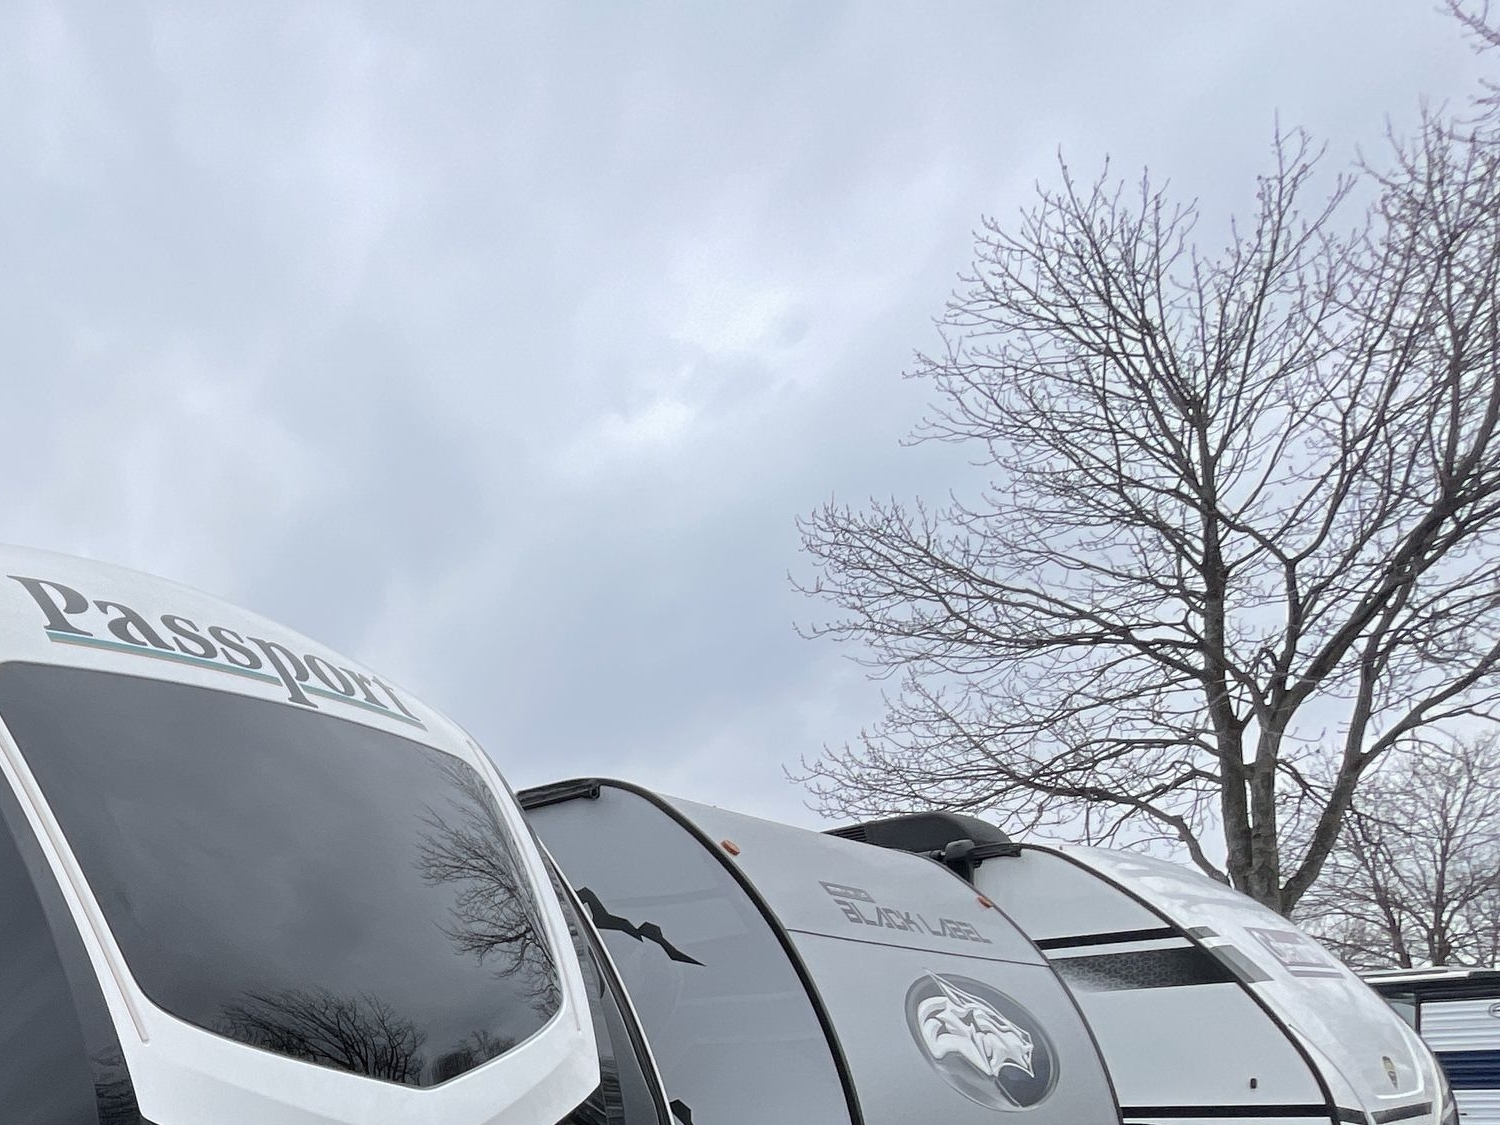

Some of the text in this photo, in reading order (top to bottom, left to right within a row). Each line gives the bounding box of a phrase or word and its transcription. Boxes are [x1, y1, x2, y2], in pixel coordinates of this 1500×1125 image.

[7, 574, 421, 722] Passport
[832, 898, 993, 944] BLACK LABEL
